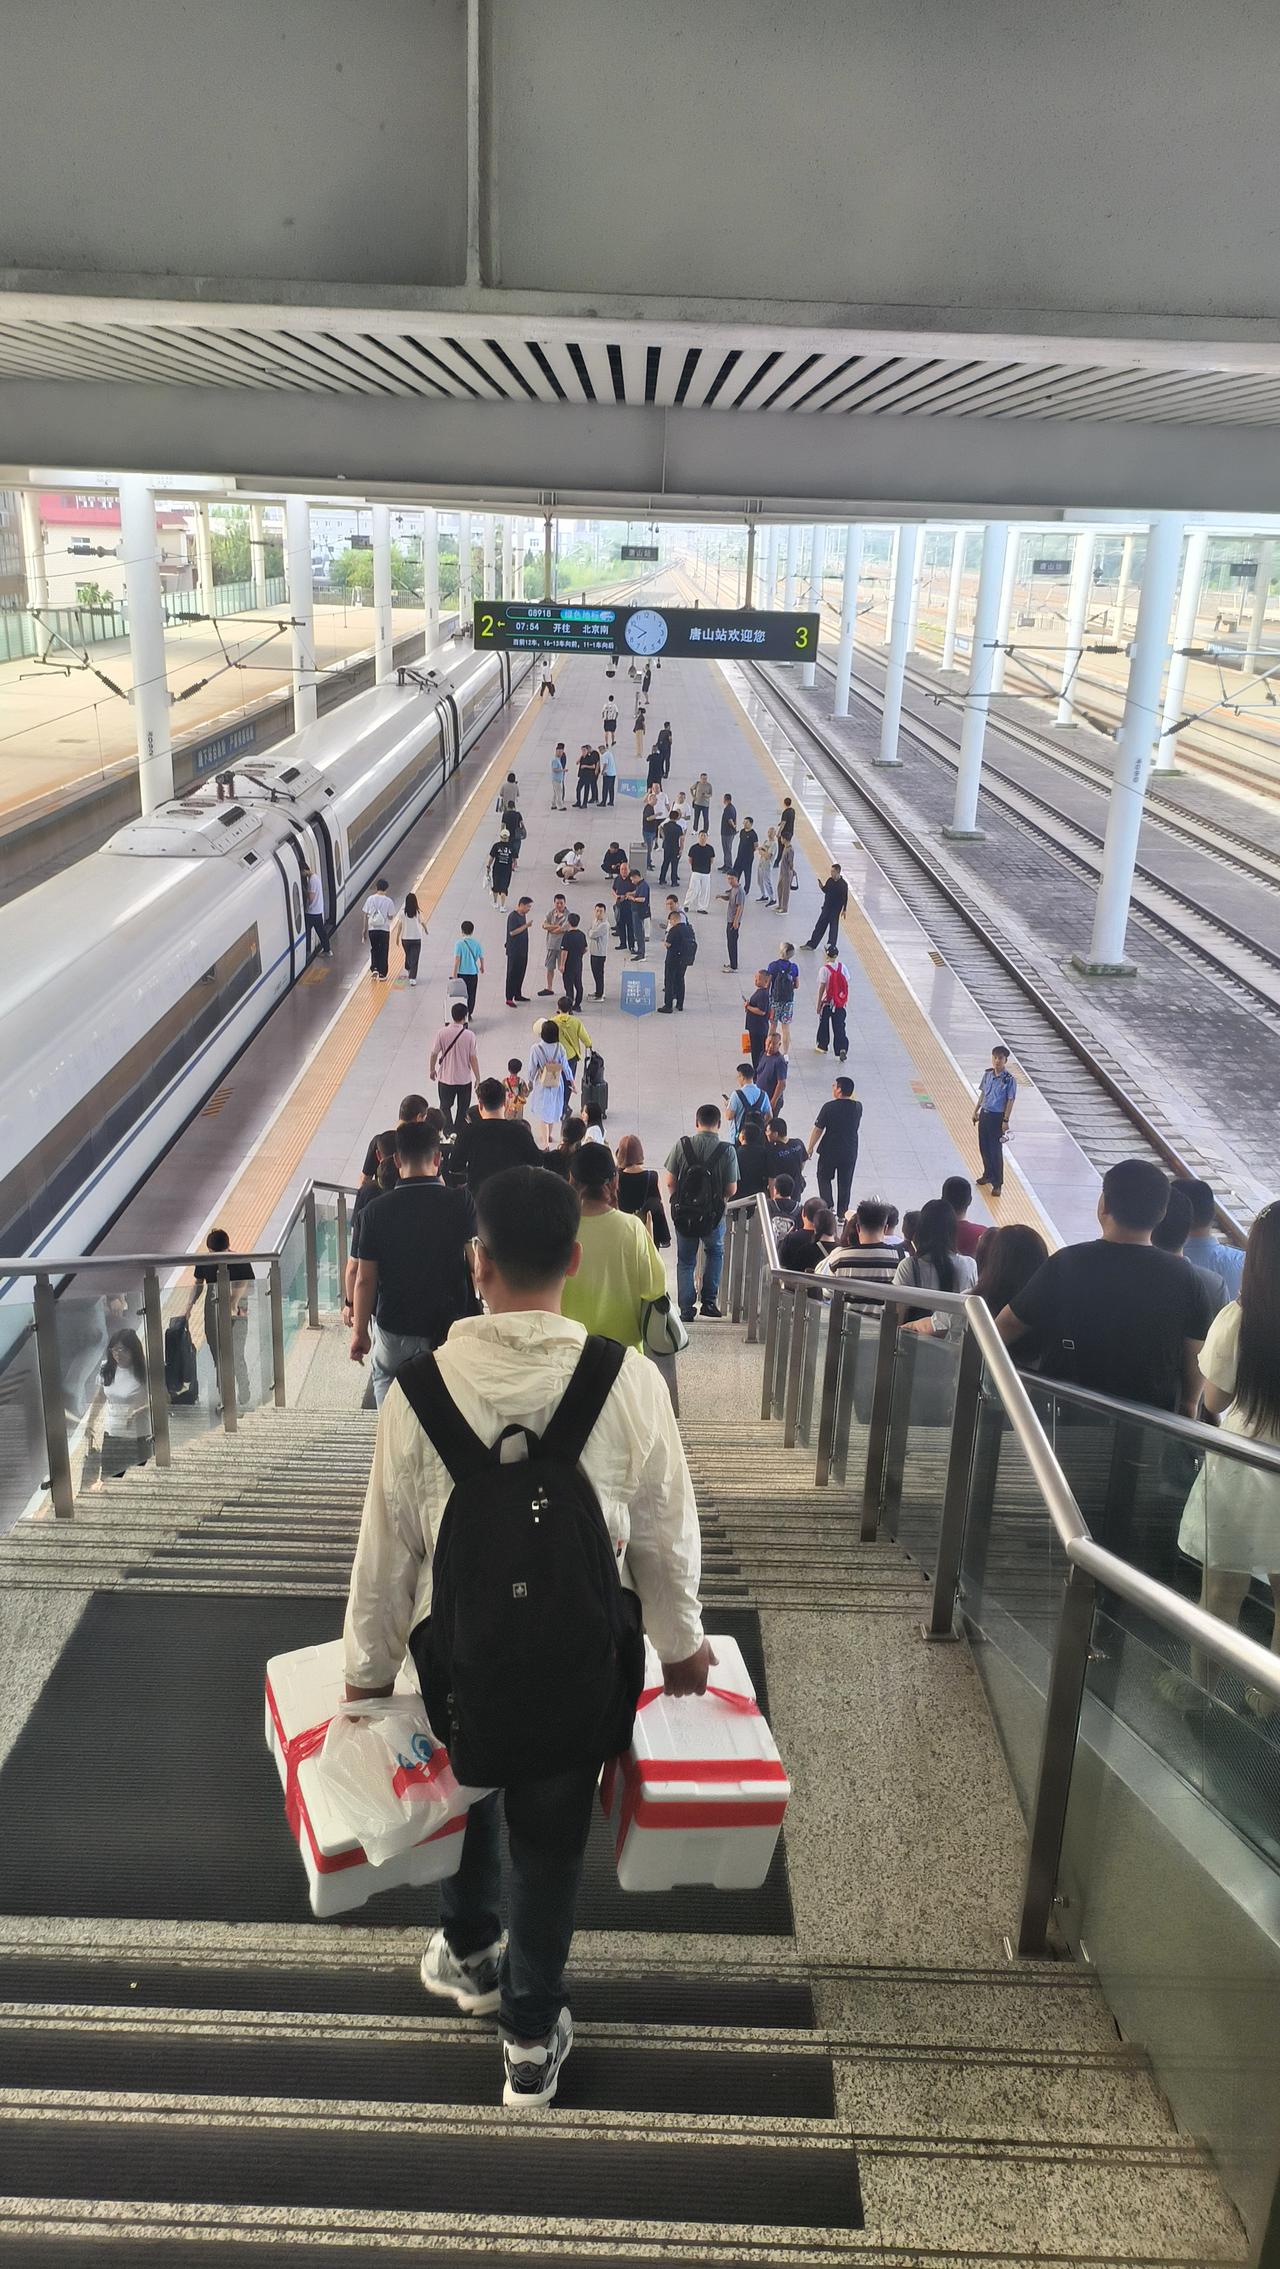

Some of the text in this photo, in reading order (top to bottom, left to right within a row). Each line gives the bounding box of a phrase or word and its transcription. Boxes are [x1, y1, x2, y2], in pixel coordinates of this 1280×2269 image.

[481, 615, 494, 637] 2
[553, 623, 609, 635] 开往 北京南
[689, 627, 766, 643] 唐山站欢迎您
[795, 627, 808, 648] 3
